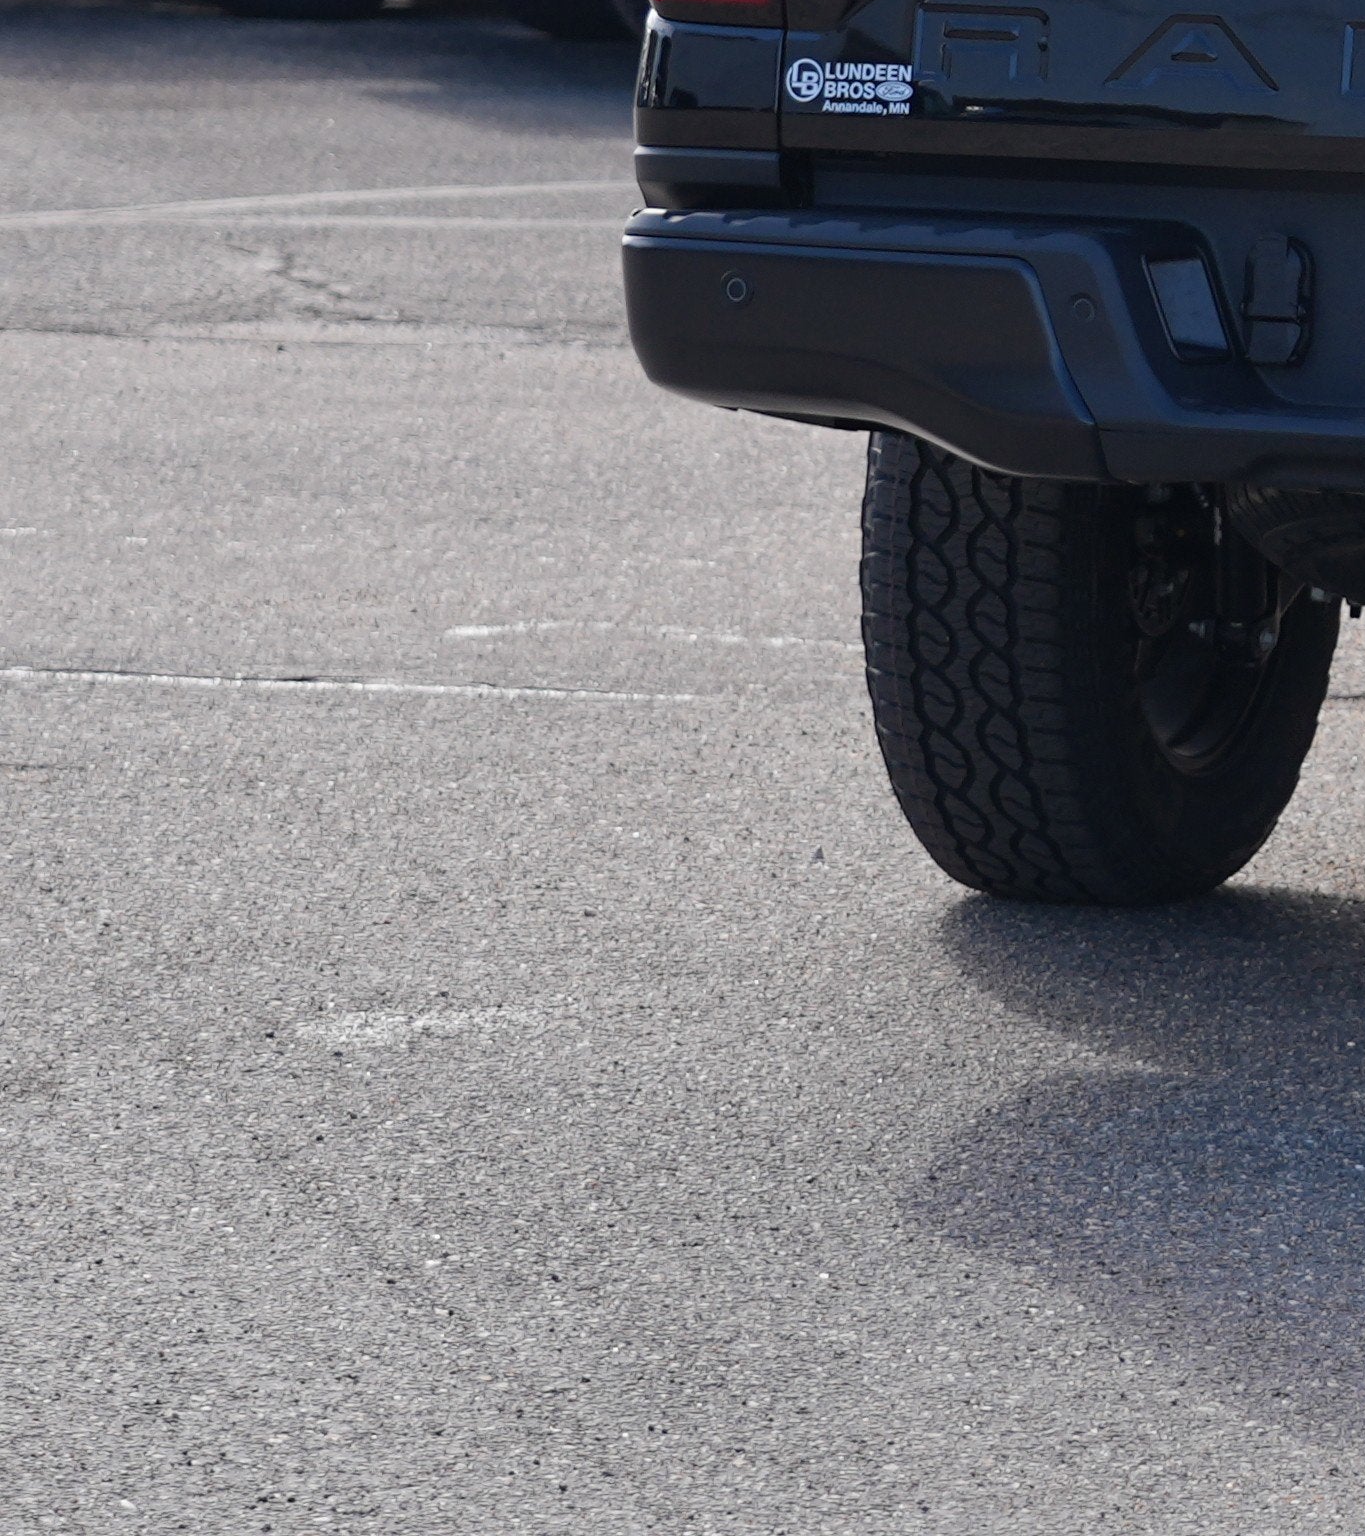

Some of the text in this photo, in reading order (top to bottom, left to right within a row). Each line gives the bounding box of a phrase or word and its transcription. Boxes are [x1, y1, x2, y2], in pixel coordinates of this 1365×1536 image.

[825, 61, 913, 82] LUNDEEN
[823, 81, 876, 100] BROS
[822, 99, 910, 116] Annandale, MN
